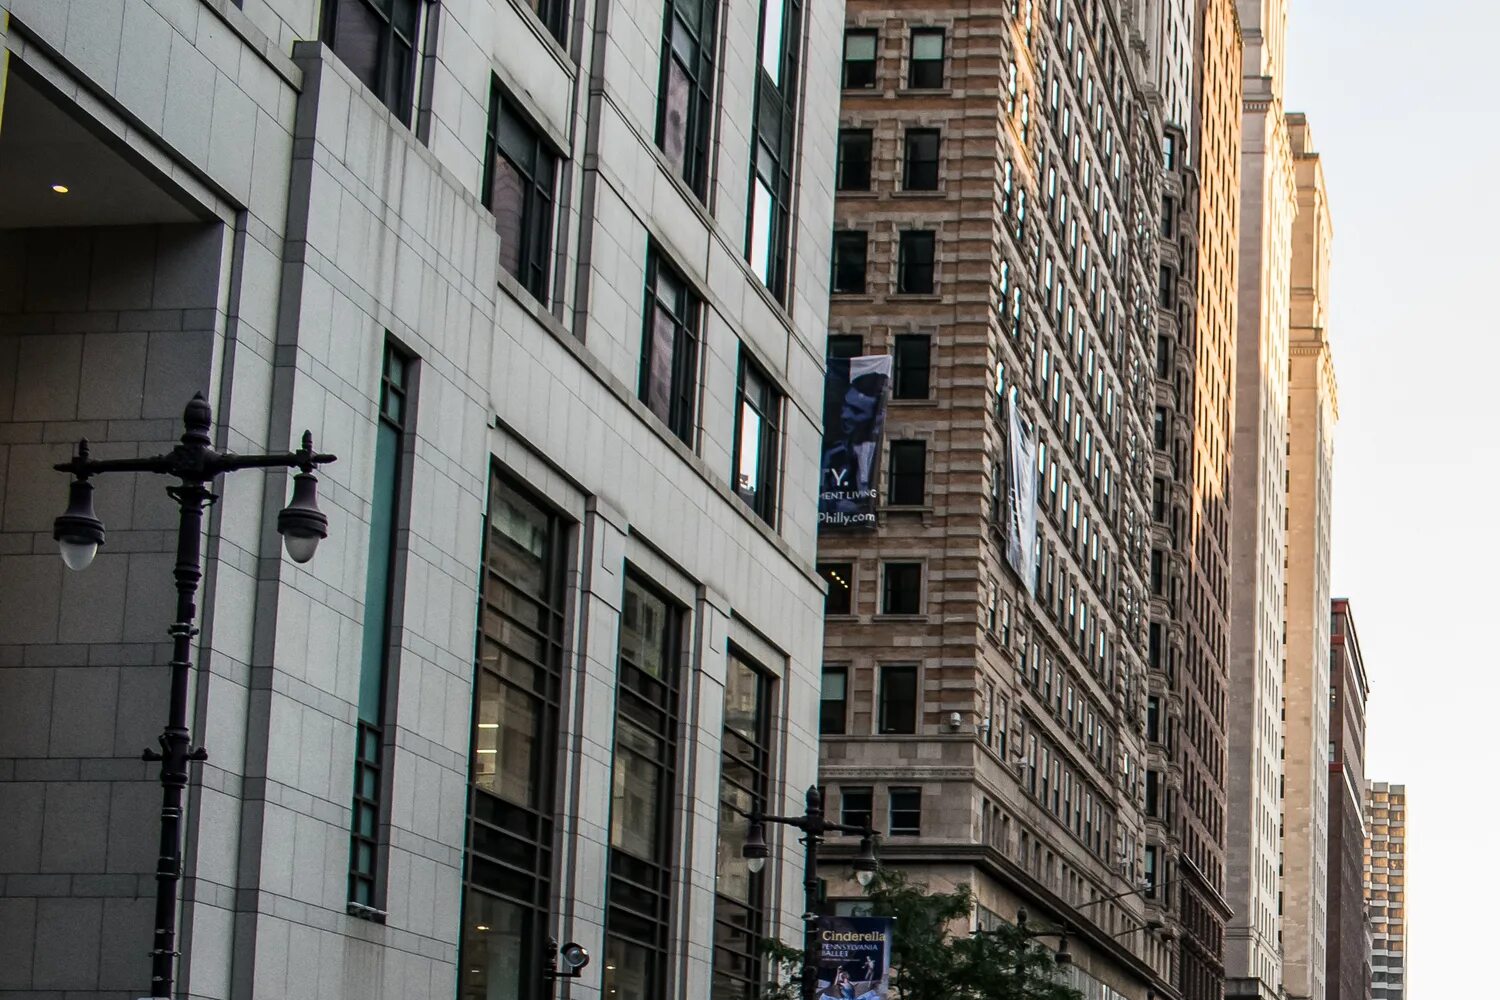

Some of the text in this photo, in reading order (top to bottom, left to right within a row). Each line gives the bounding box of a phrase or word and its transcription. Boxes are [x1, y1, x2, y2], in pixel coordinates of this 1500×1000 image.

[846, 489, 877, 500] LIVING
[822, 930, 886, 941] Cinderella
[821, 943, 878, 951] PENNSYLVANIA
